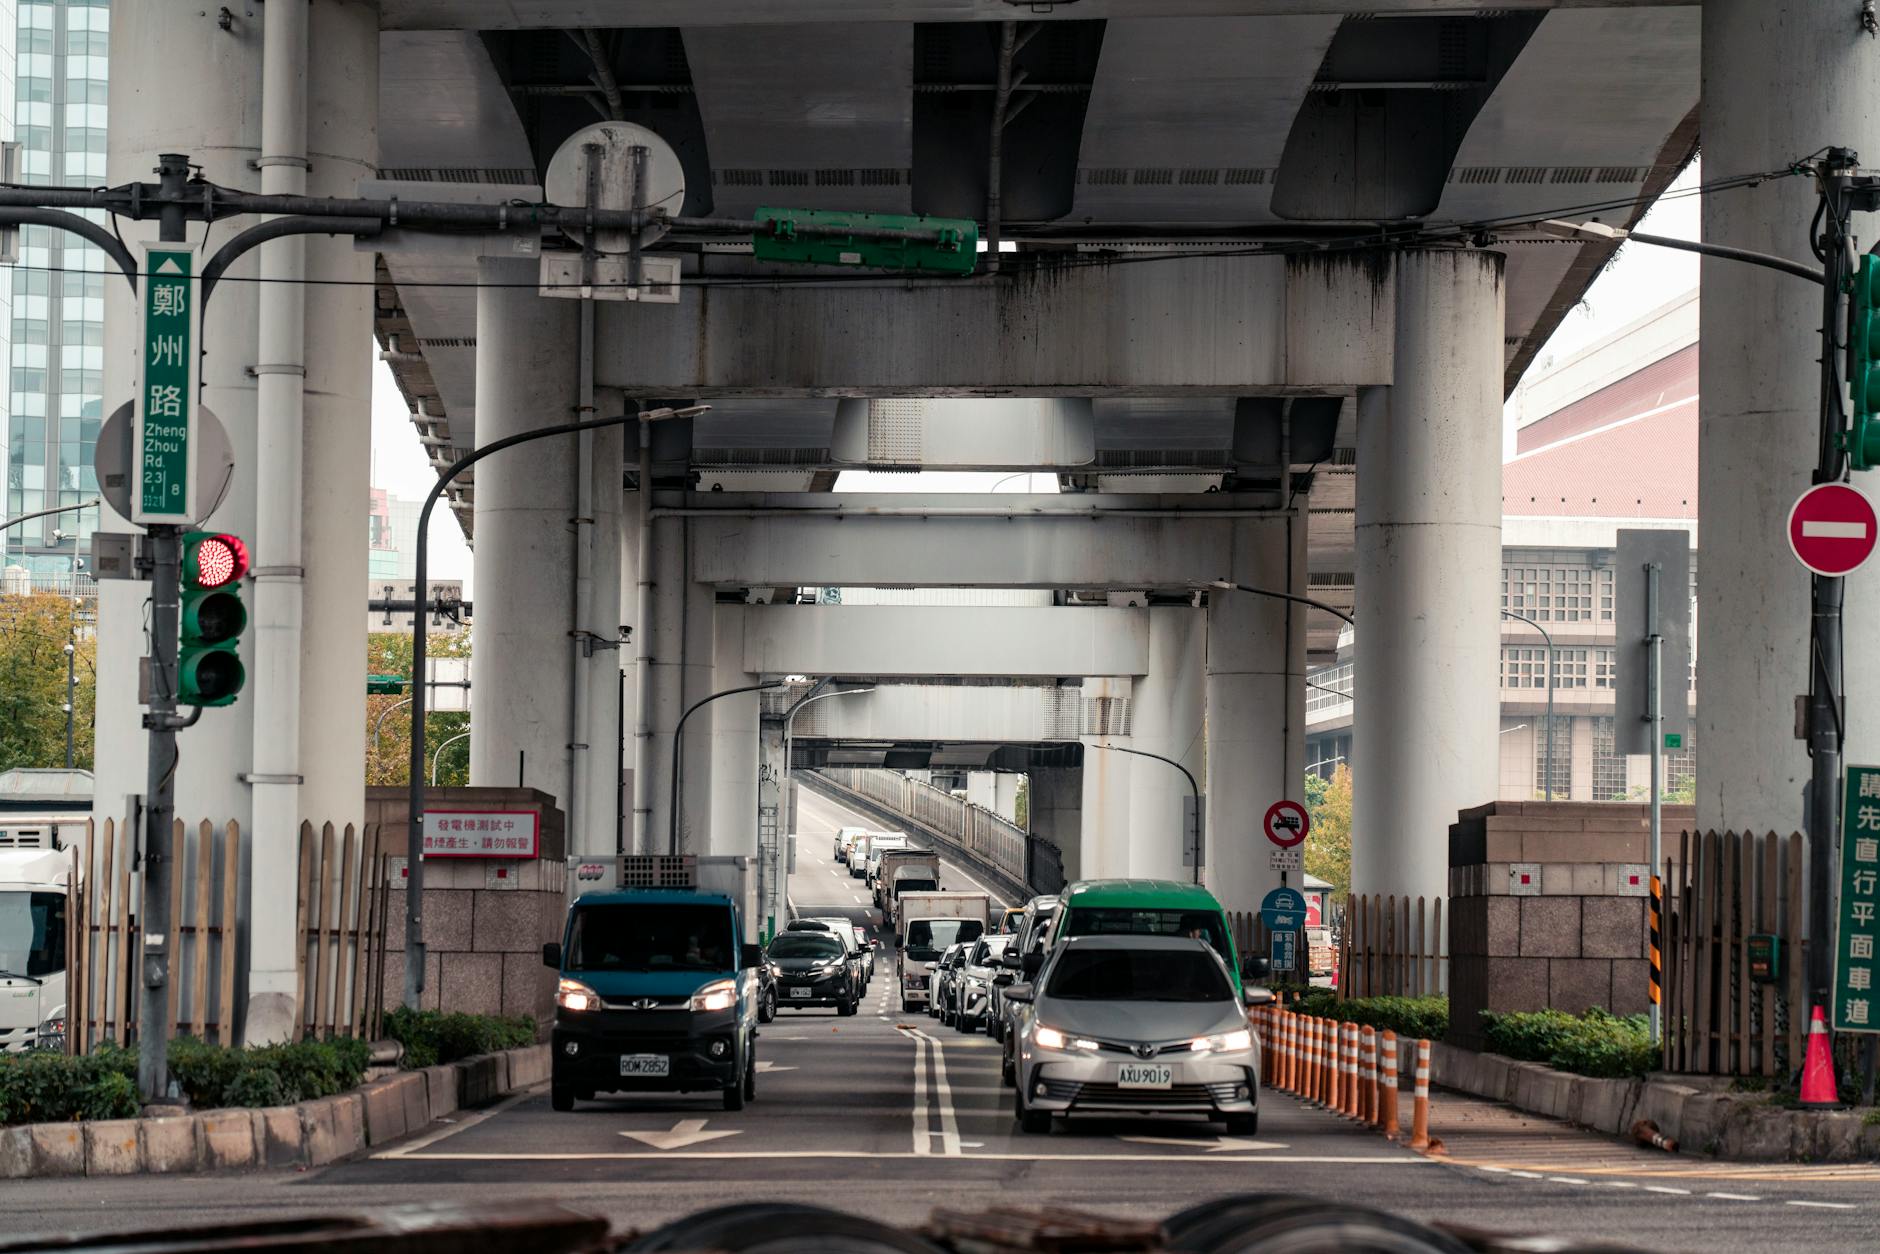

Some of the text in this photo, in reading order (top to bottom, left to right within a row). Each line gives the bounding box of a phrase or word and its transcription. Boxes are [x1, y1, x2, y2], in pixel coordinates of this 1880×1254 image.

[150, 284, 185, 417] 鄭州路
[145, 422, 187, 441] Zheng
[145, 438, 179, 453] Zhou
[145, 454, 166, 468] Rd.
[144, 471, 163, 484] 23
[171, 483, 180, 496] 8
[438, 819, 515, 832] 發電機測試中
[1844, 772, 1880, 1024] 請先直行平面車道
